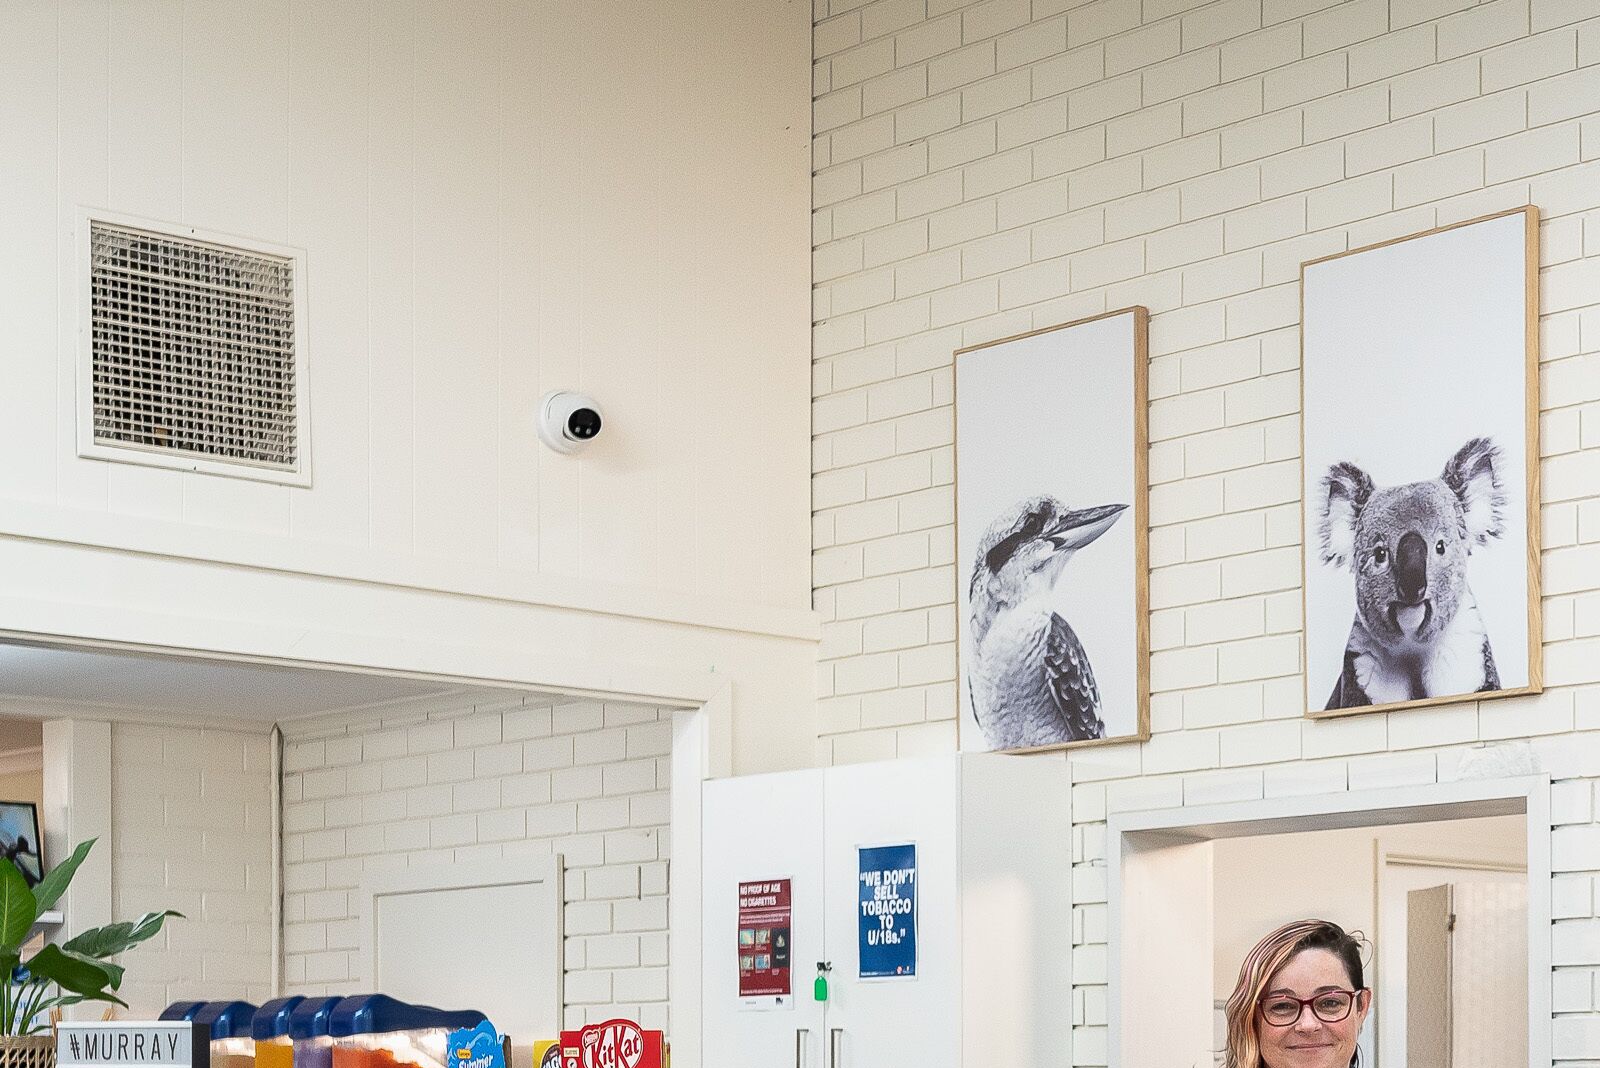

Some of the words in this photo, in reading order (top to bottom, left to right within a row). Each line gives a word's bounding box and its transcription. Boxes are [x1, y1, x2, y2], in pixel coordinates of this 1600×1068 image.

[860, 870, 881, 887] "WE
[884, 869, 915, 885] DON'T
[874, 885, 899, 900] SELL
[862, 898, 911, 916] TOBACCO
[879, 915, 894, 930] TO
[69, 1033, 178, 1060] #MURRAY
